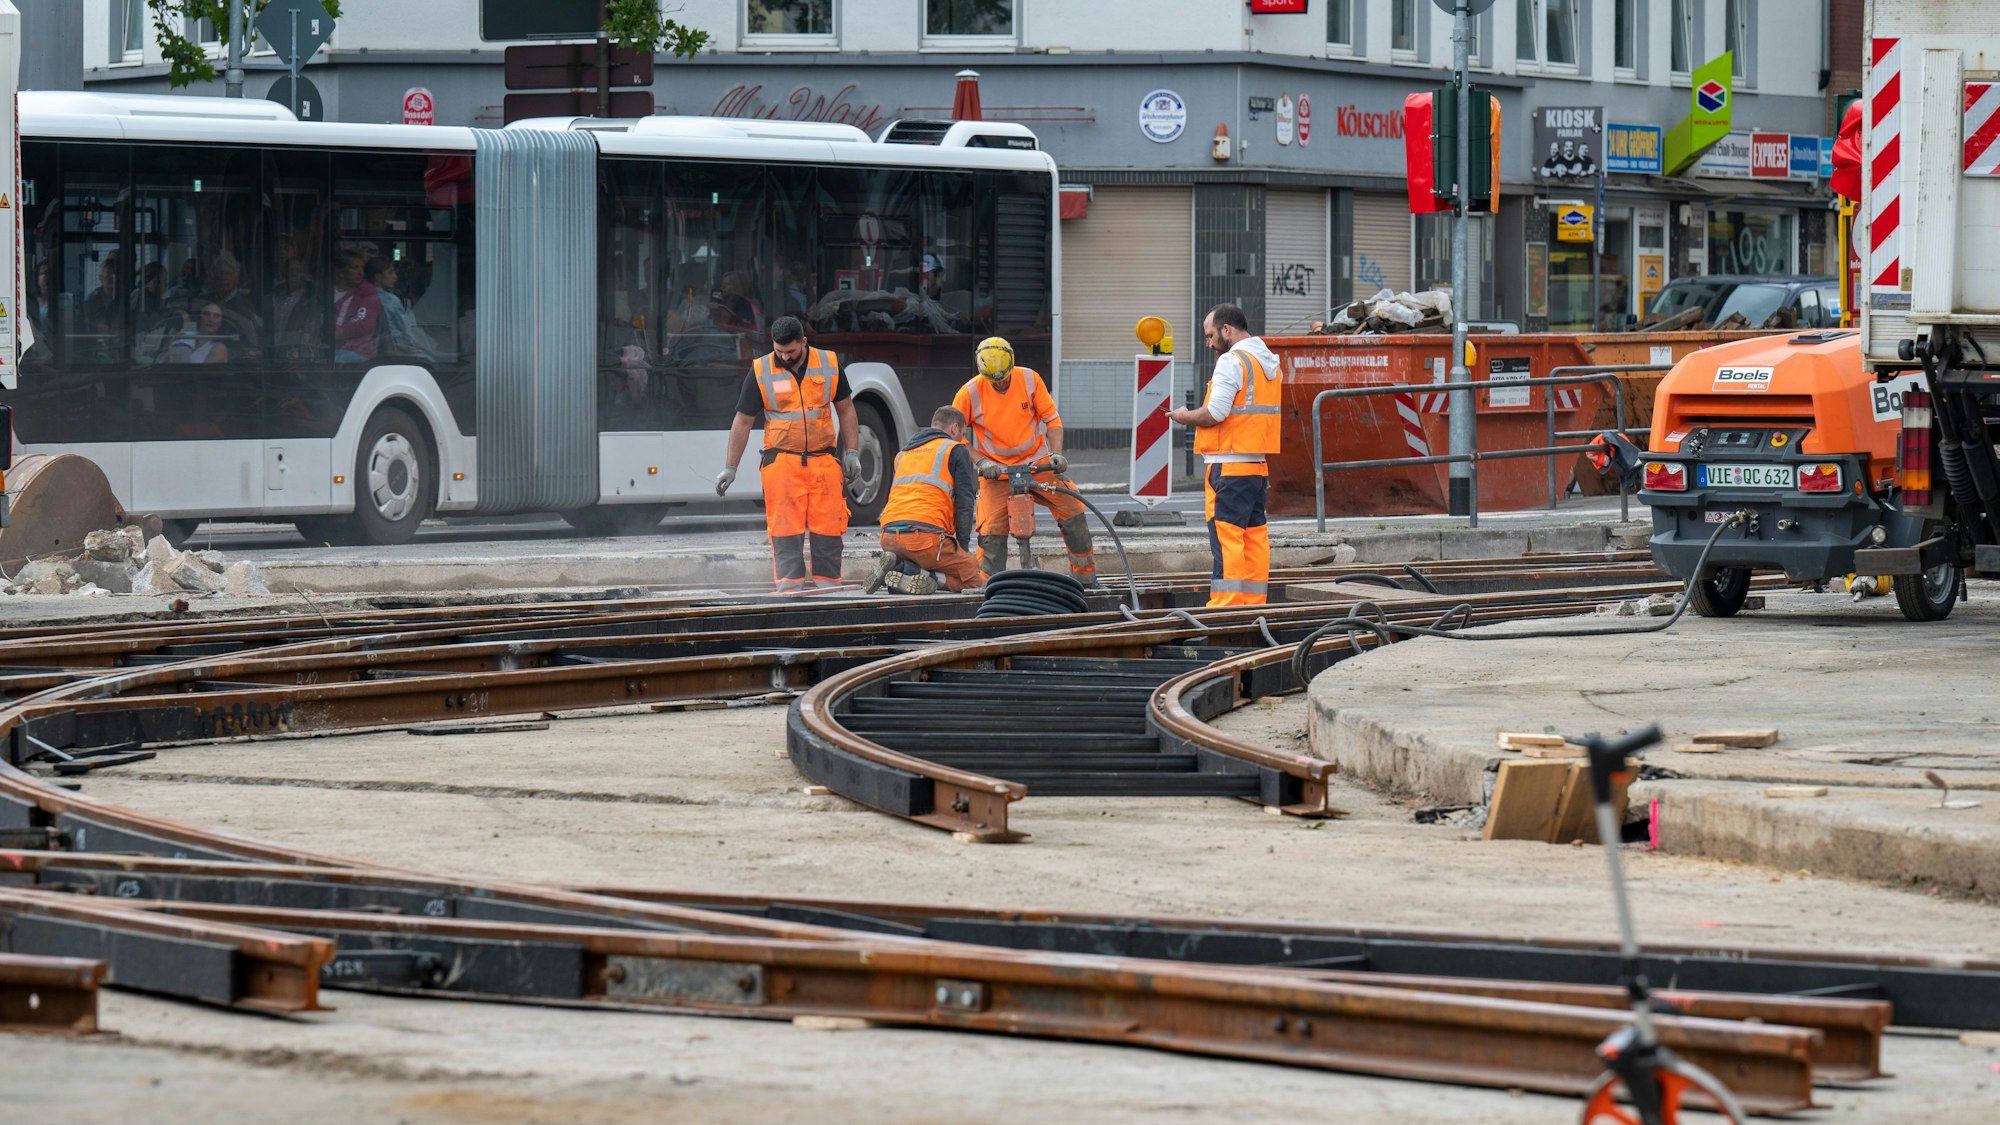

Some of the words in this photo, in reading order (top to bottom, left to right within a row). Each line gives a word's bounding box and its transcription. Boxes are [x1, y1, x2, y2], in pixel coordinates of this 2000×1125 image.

[1545, 109, 1596, 128] KIOSK
[1753, 142, 1787, 168] EXPRESS
[1718, 369, 1769, 380] Boels
[1707, 467, 1732, 484] VIE
[1743, 468, 1761, 484] QC
[1764, 469, 1790, 485] 632
